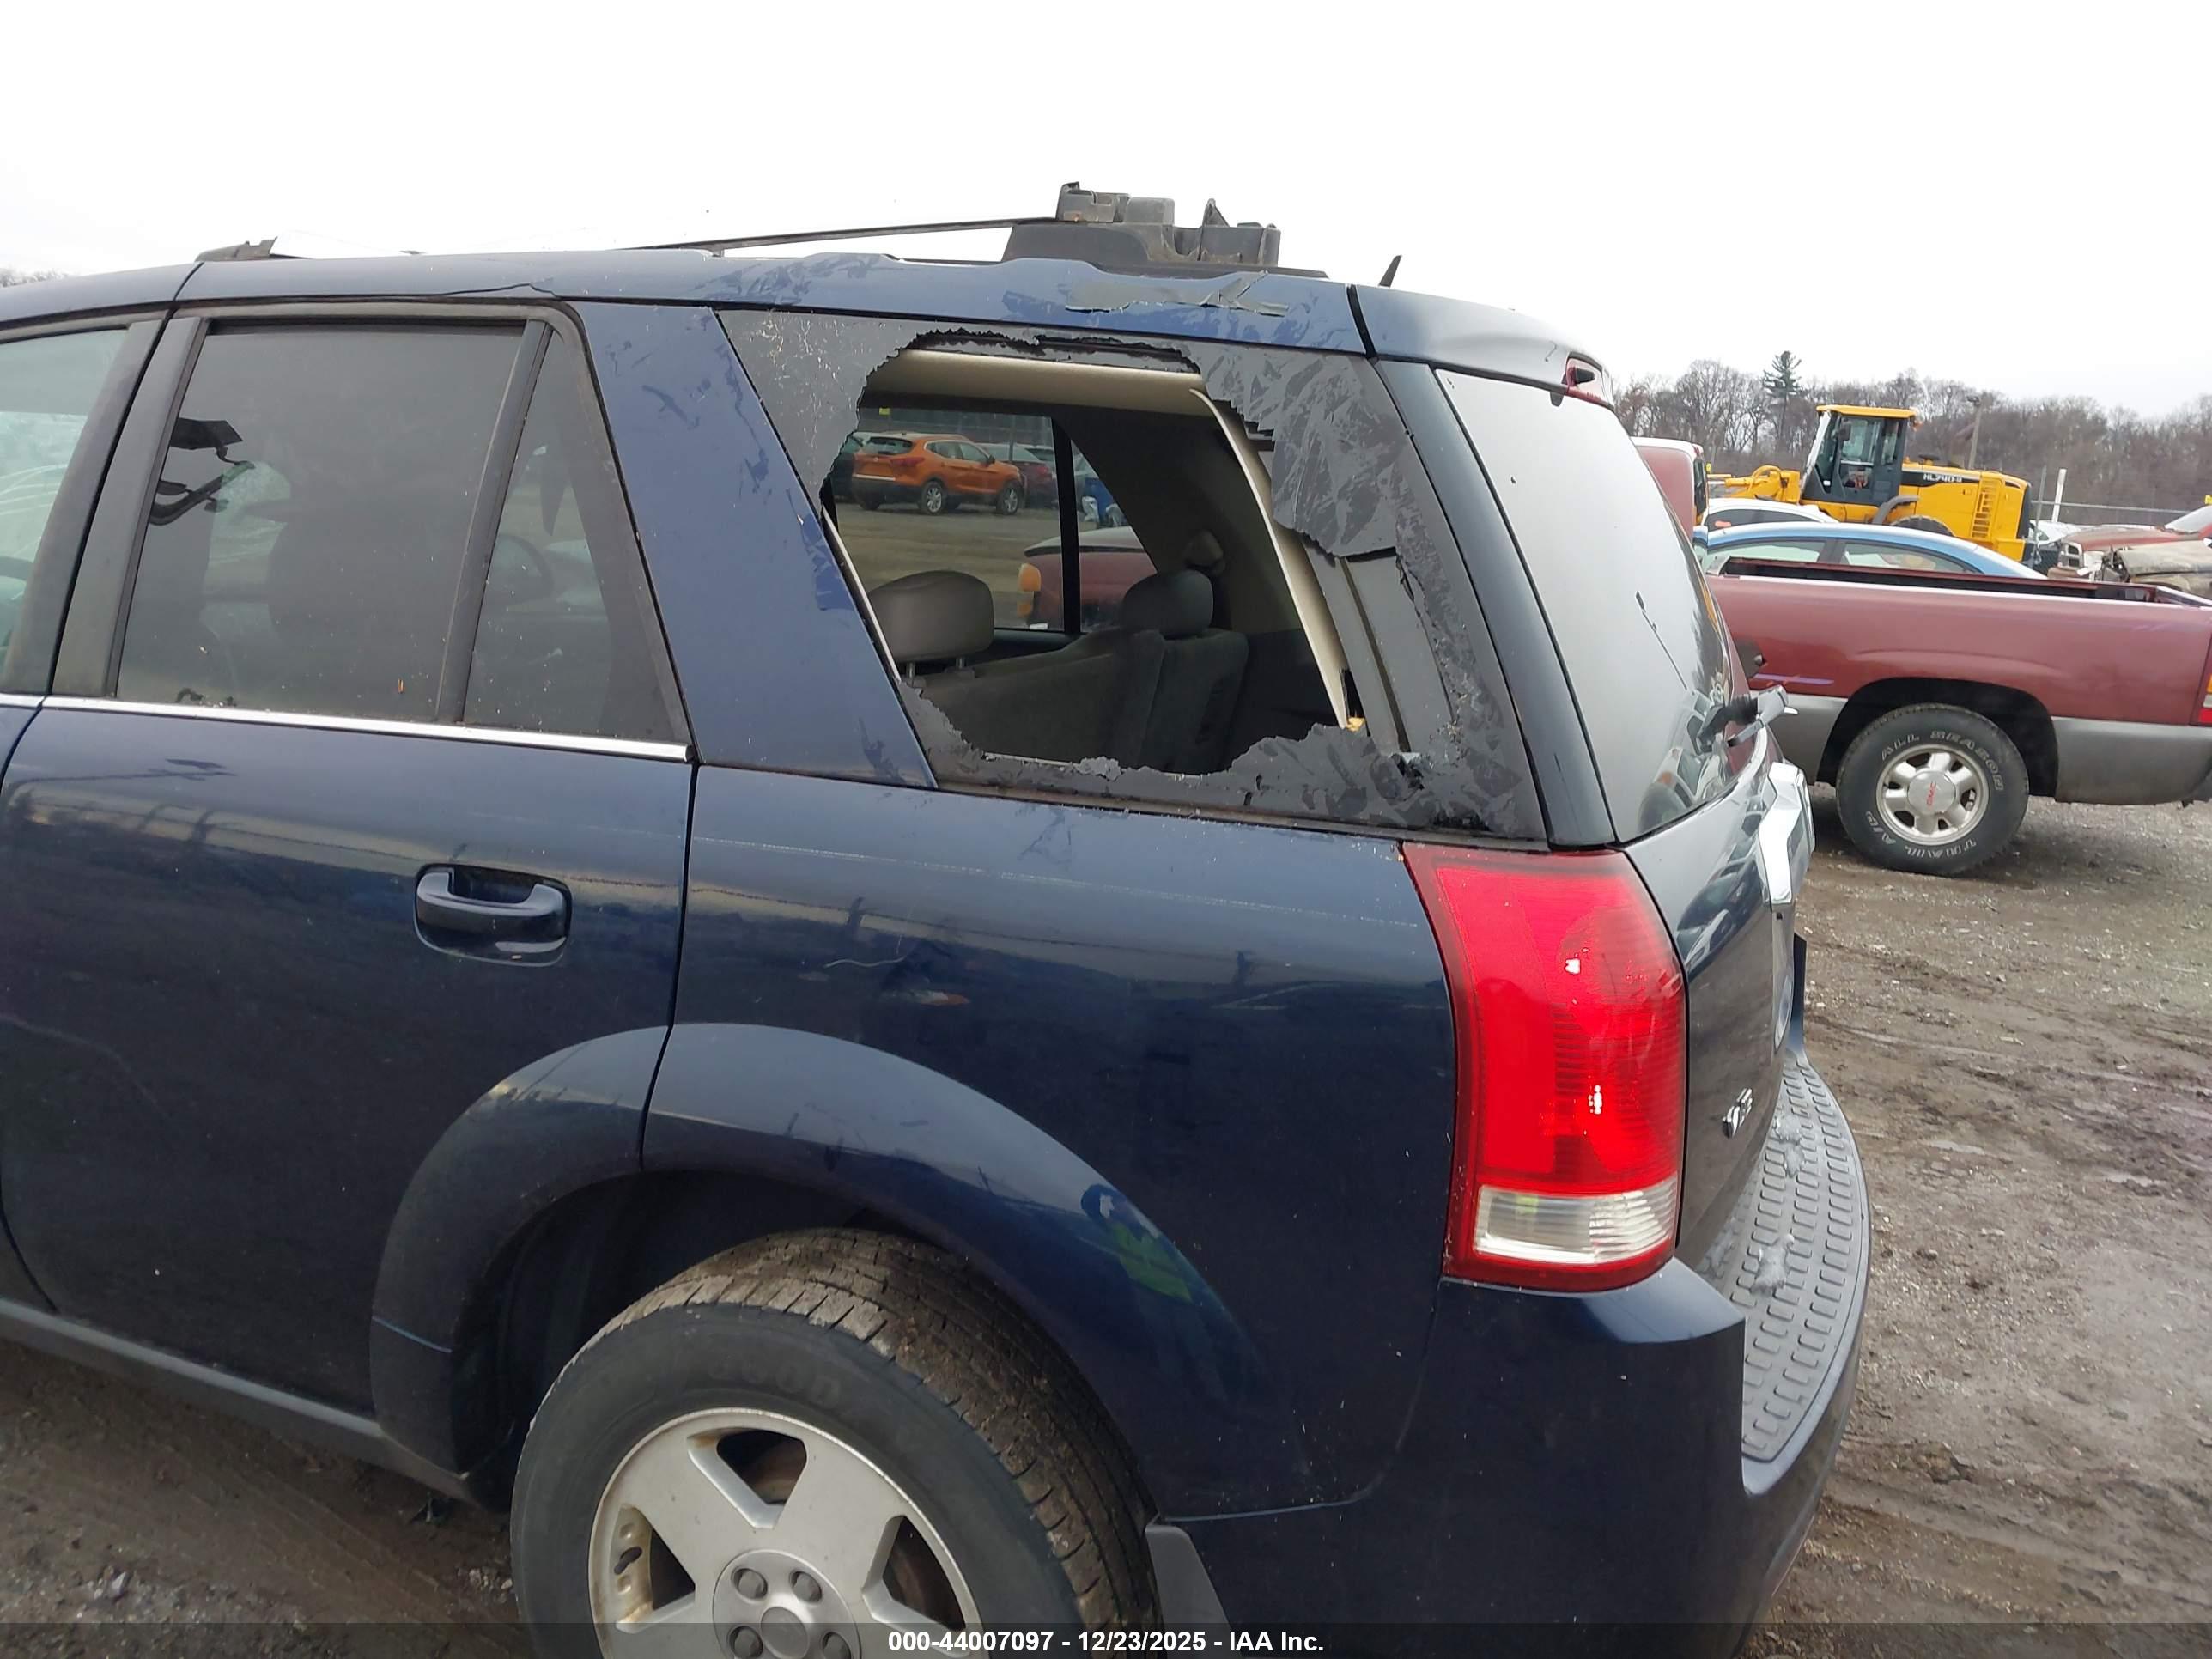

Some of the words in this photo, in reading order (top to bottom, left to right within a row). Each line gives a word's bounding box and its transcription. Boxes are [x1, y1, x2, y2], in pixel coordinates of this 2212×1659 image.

[1881, 733, 1920, 761] ALL
[1929, 730, 2004, 791] SEASON
[1925, 781, 1937, 806] GMC
